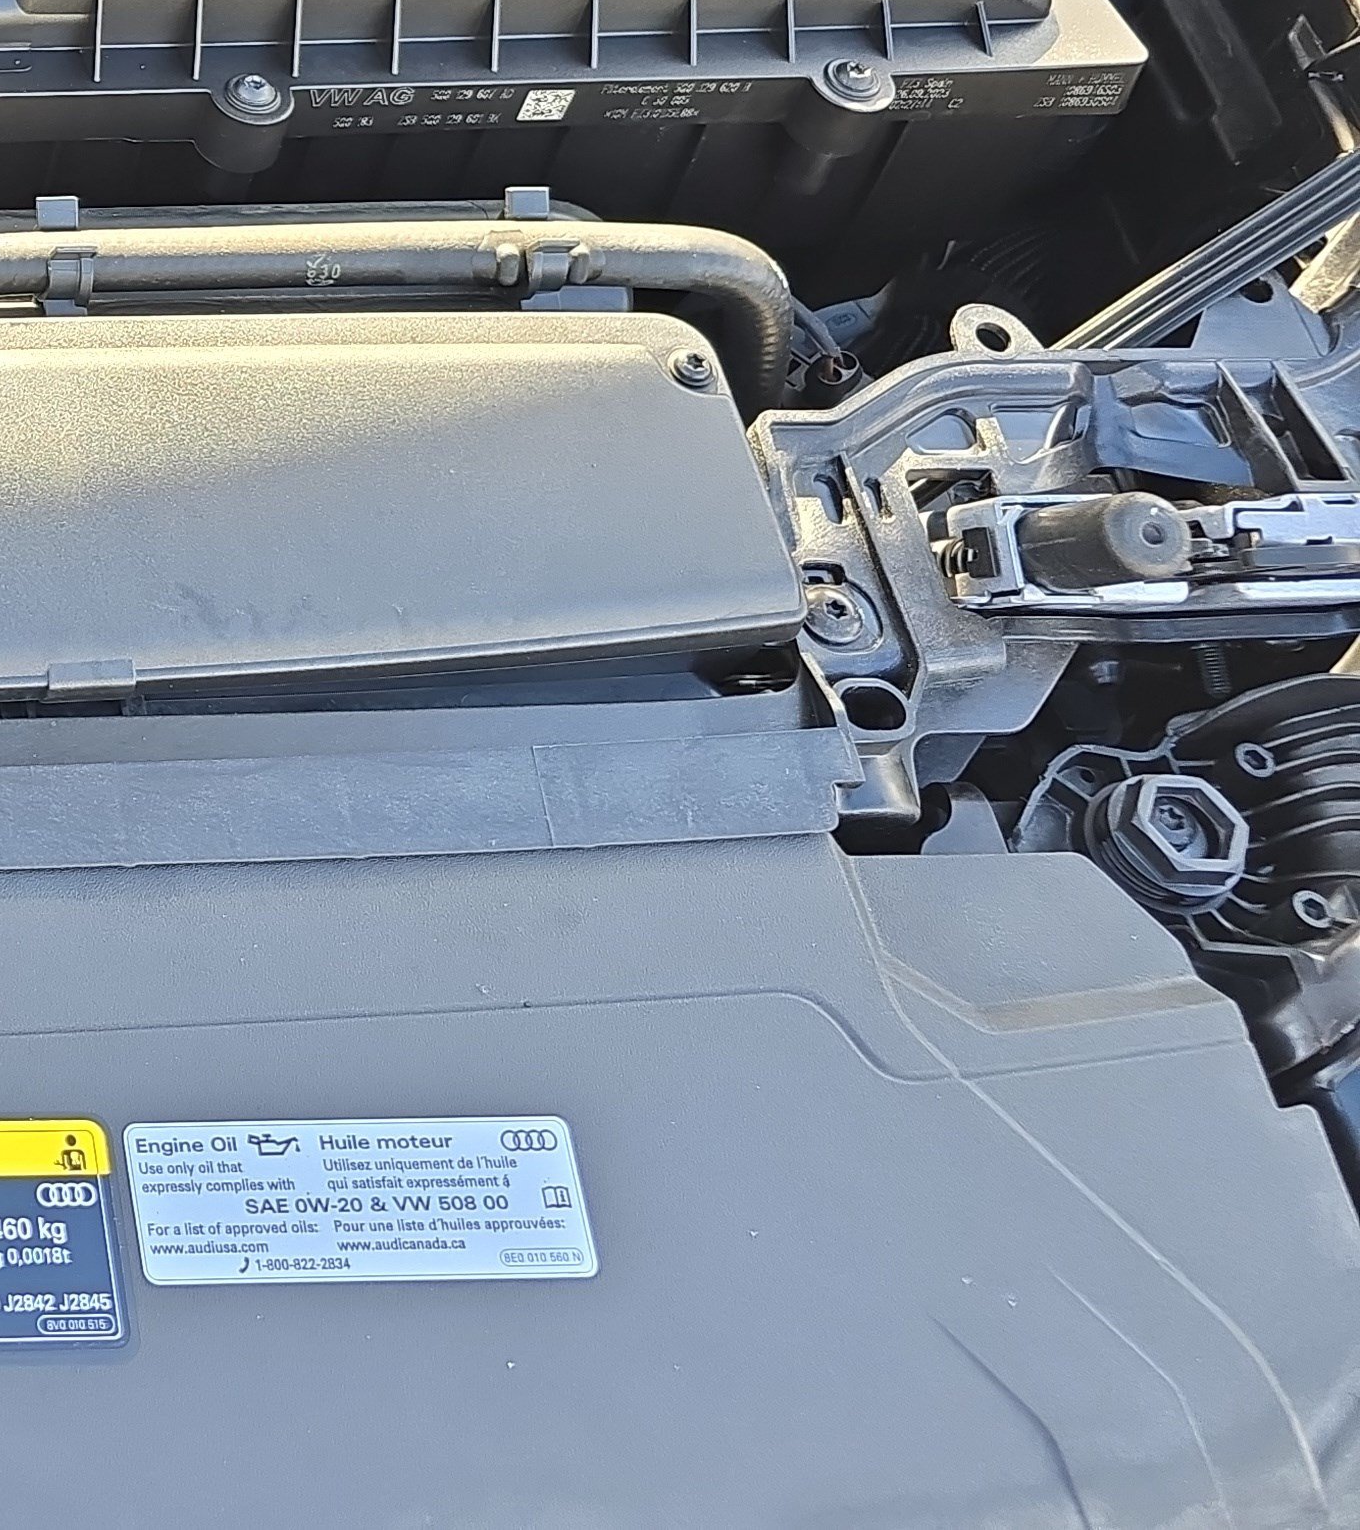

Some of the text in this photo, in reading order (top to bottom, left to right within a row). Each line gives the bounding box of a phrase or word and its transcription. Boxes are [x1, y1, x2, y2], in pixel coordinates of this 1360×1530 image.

[924, 77, 953, 88] Spain
[310, 86, 415, 107] VW AG
[135, 1136, 238, 1156] Engine Oil
[319, 1135, 453, 1150] Huile moteur
[138, 1161, 243, 1176] Use only oil that
[322, 1158, 372, 1171] Utilisez
[375, 1157, 453, 1173] uniquement
[457, 1156, 473, 1169] de
[141, 1178, 296, 1195] expressly complies with
[327, 1175, 499, 1193] qui satisfait expressément
[245, 1194, 509, 1214] SAE 0W-20 & VW 508 00
[37, 1217, 68, 1244] kg
[147, 1220, 319, 1238] For a list of approved oils:
[333, 1219, 365, 1232] Pour
[375, 1220, 394, 1232] une
[397, 1218, 424, 1232] liste
[484, 1217, 566, 1233] approuvées:
[150, 1240, 269, 1255] www.audiusa.com
[337, 1237, 467, 1252] www.audicanada.ca
[7, 1247, 73, 1267] 0,0018t
[255, 1257, 351, 1271] 1-800-822-2834
[528, 1252, 546, 1263] 010
[550, 1251, 569, 1262] 560
[572, 1251, 582, 1262] N
[3, 1294, 56, 1312] J2842
[59, 1293, 113, 1311] J2845
[67, 1319, 85, 1330] 010
